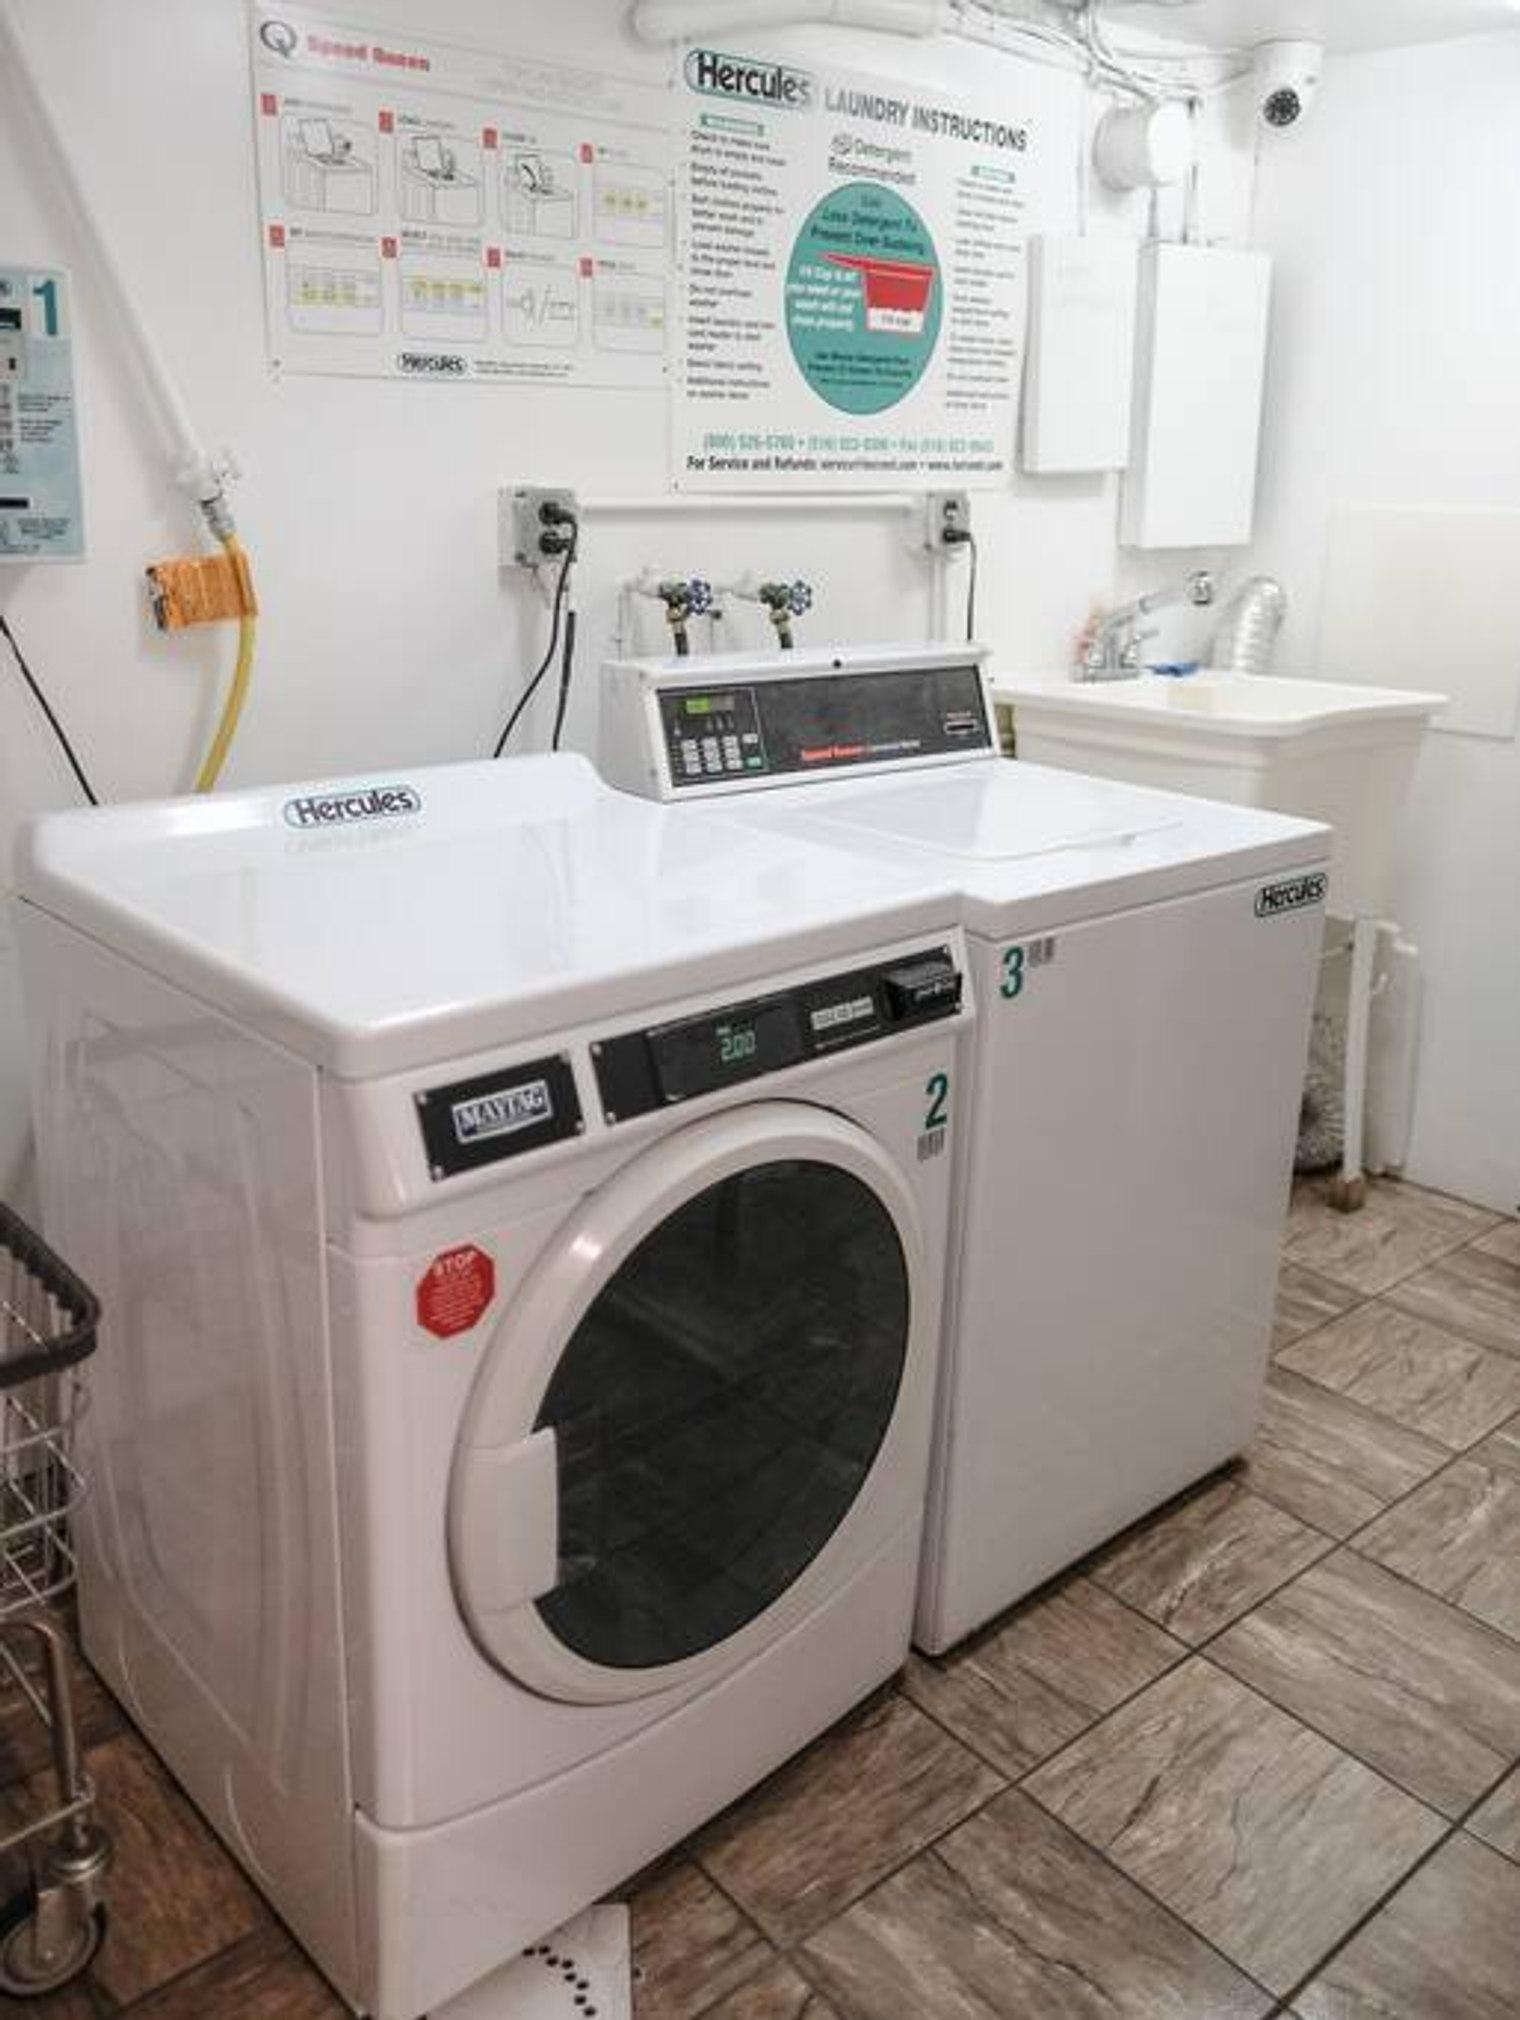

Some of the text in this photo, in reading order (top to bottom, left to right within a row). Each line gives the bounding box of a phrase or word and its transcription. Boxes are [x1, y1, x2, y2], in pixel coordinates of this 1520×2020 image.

[697, 51, 1028, 153] Hercules LAUNDRY INSTRUCTIONS
[855, 137, 912, 164] Detergent
[829, 156, 916, 185] Recommended
[33, 280, 58, 335] 1
[687, 454, 705, 471] For
[708, 454, 750, 471] Service
[752, 456, 771, 471] and
[294, 789, 413, 824] Hercules
[1260, 877, 1324, 911] Hercules
[1000, 945, 1024, 999] 3
[458, 1085, 545, 1128] MAYTAG
[925, 1072, 948, 1129] 2
[433, 1250, 478, 1278] STOP
